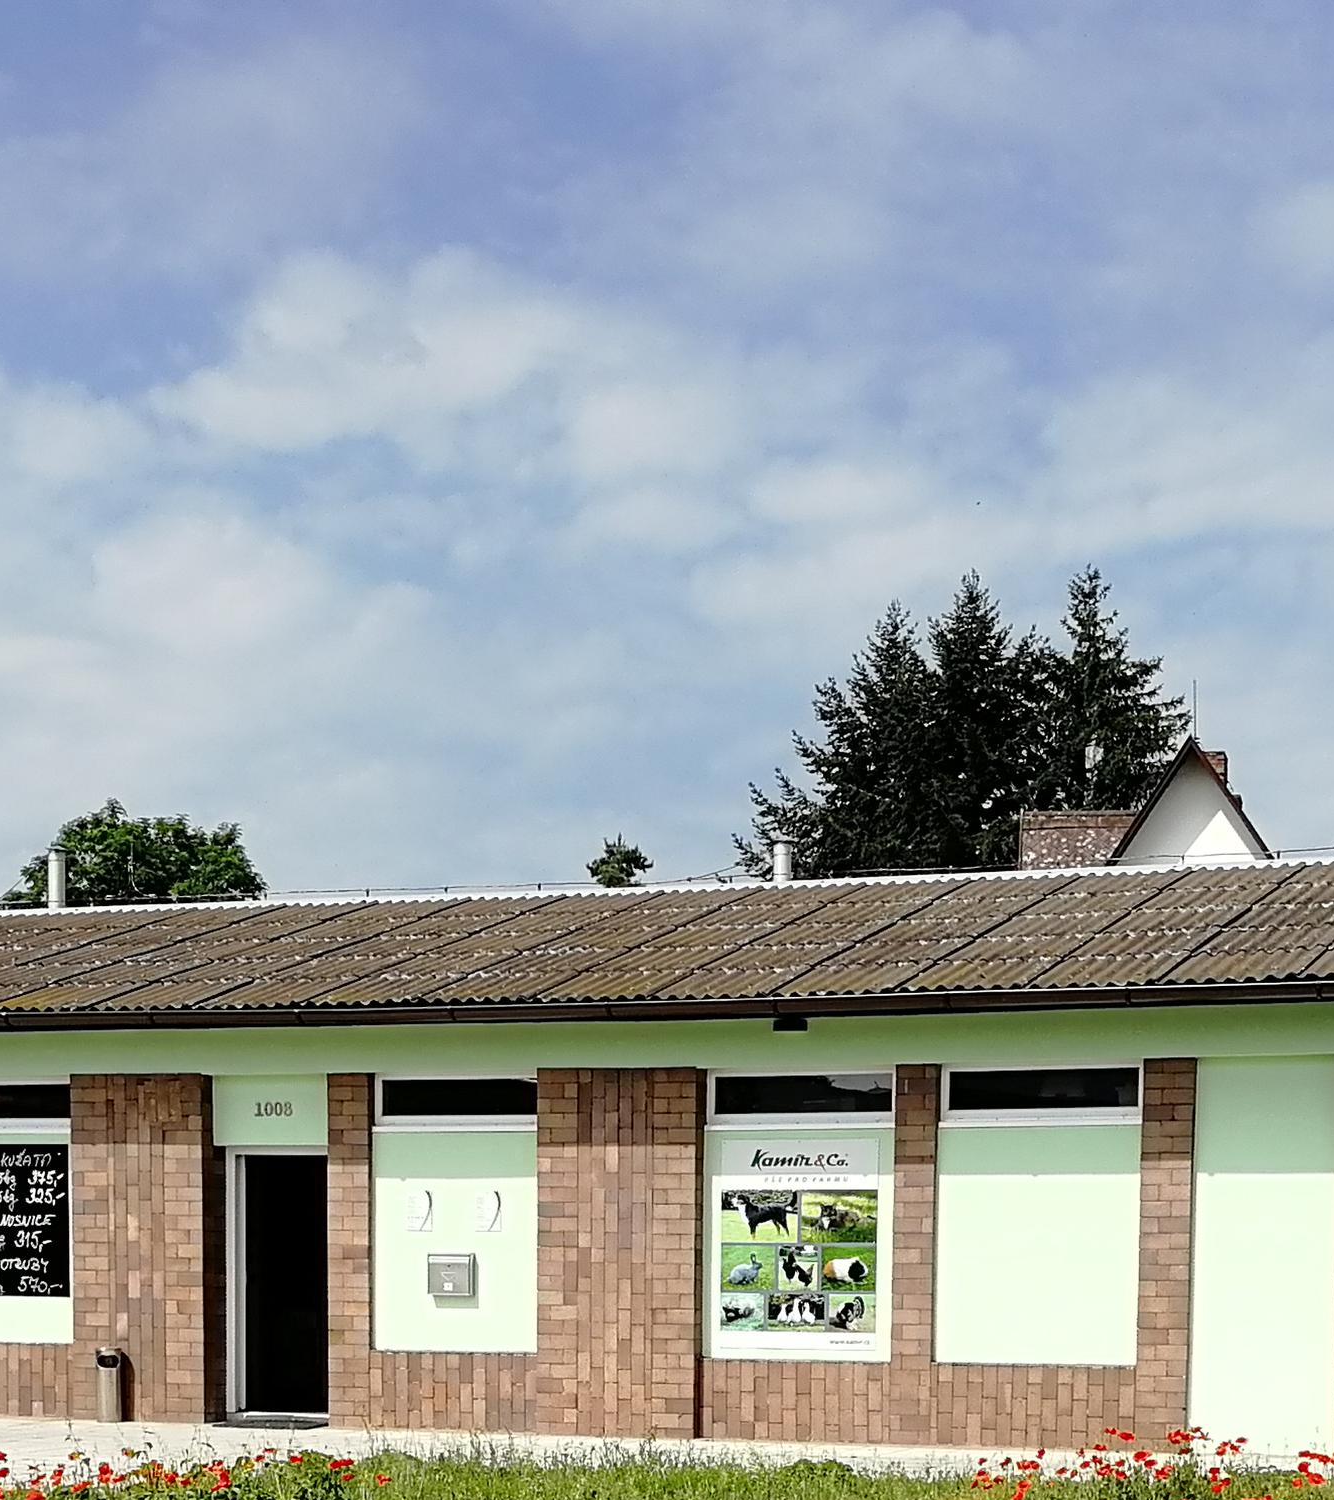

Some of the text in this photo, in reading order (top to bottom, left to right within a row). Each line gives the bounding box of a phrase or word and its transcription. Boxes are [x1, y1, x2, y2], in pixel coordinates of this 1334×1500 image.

[254, 1102, 293, 1117] 1008
[0, 1213, 57, 1227] NOSNICE
[0, 1257, 49, 1274] OTRUBY
